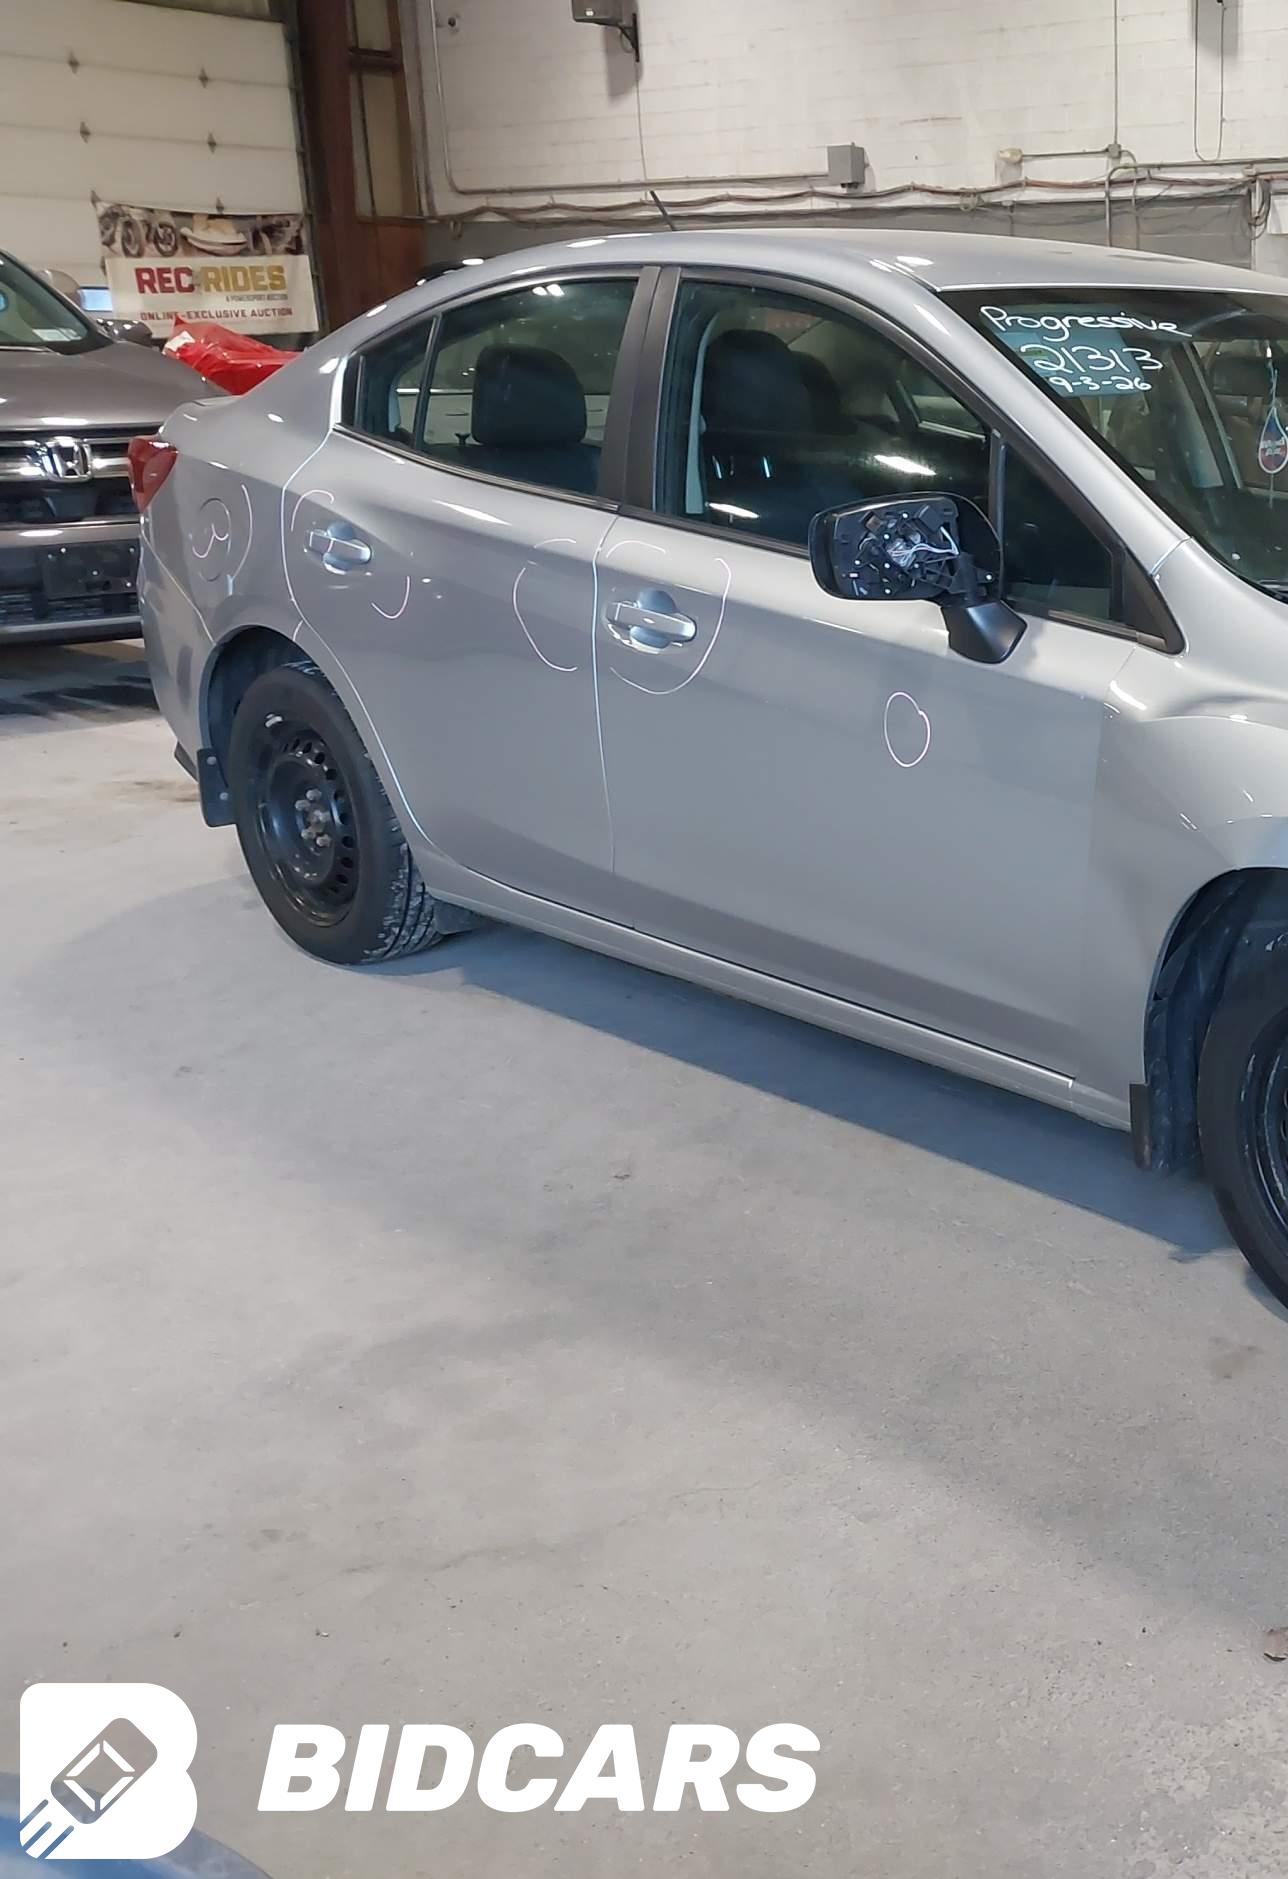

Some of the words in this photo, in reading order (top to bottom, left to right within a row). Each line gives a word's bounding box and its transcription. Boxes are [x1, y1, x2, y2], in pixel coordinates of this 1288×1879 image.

[135, 267, 195, 294] REC
[201, 265, 287, 293] RIDES
[250, 307, 293, 318] AUCTION
[980, 306, 1193, 342] Progressive
[1020, 344, 1163, 374] 21313
